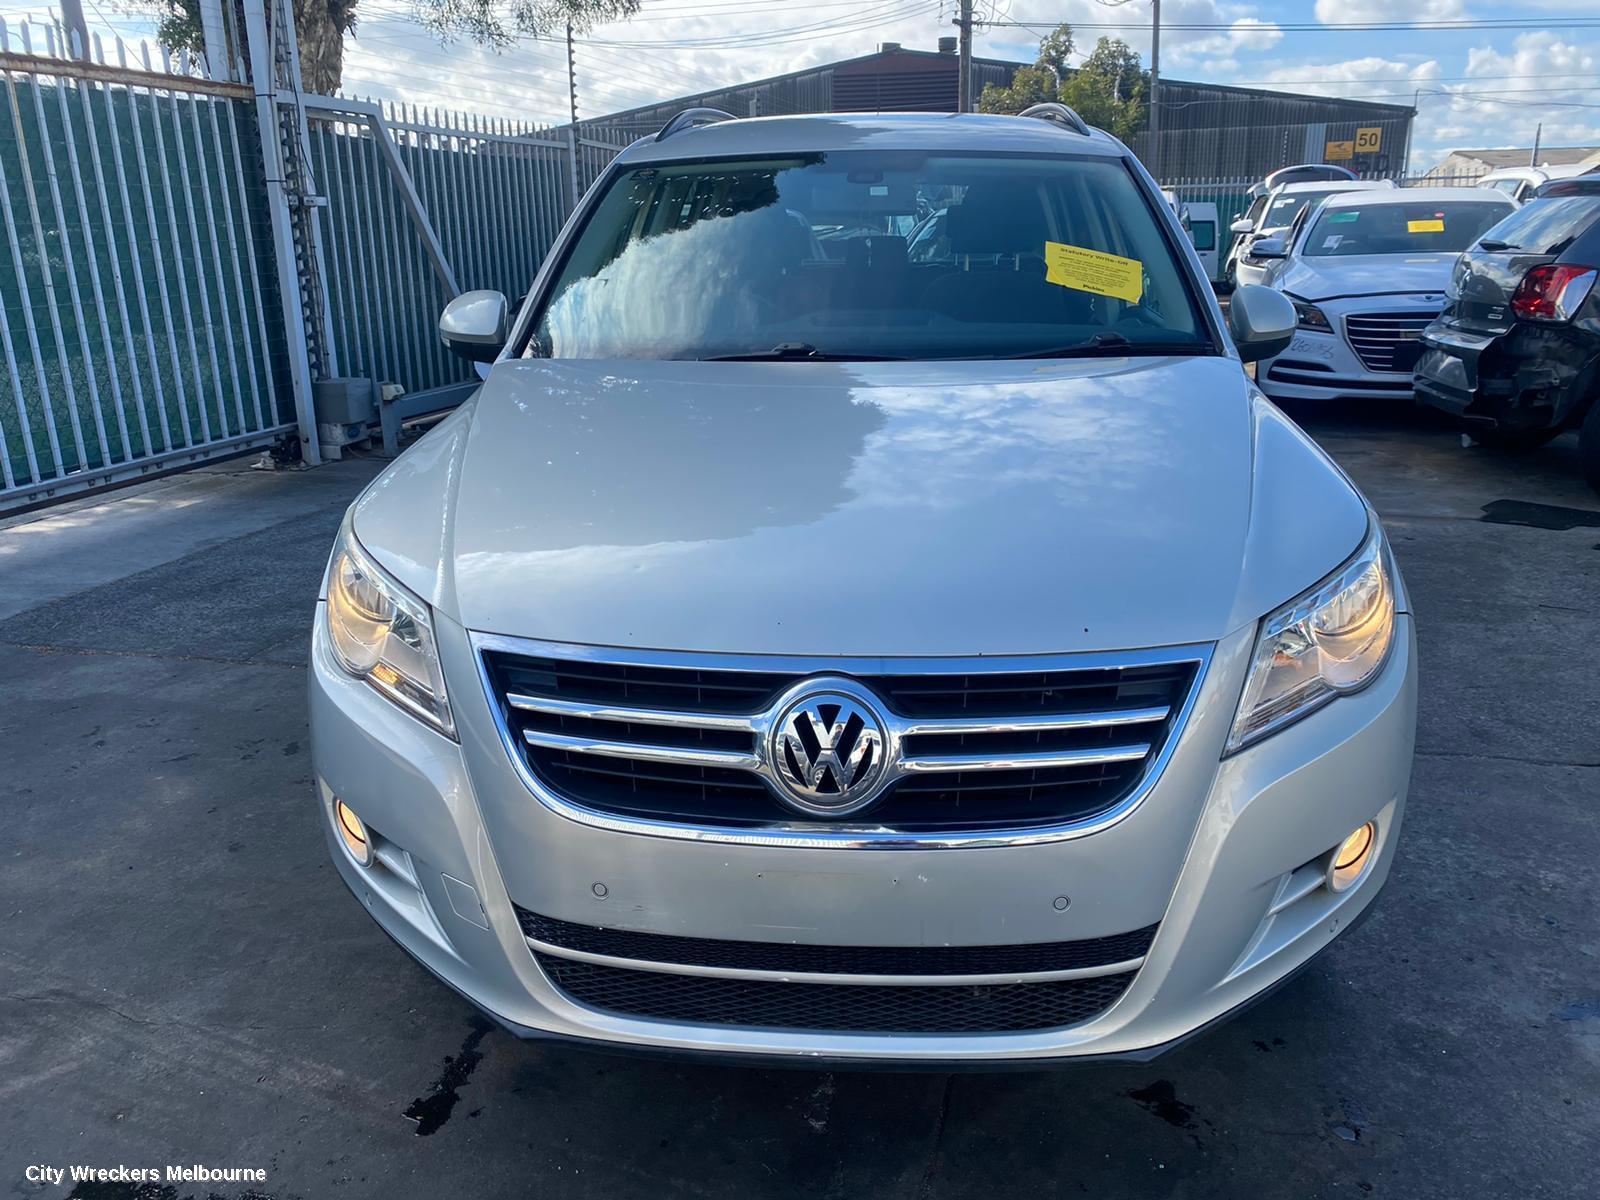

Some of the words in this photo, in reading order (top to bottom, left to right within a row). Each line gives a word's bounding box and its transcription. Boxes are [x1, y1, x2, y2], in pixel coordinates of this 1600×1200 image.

[1358, 133, 1378, 147] 50
[1060, 247, 1095, 258] Statutory
[772, 690, 887, 798] VW
